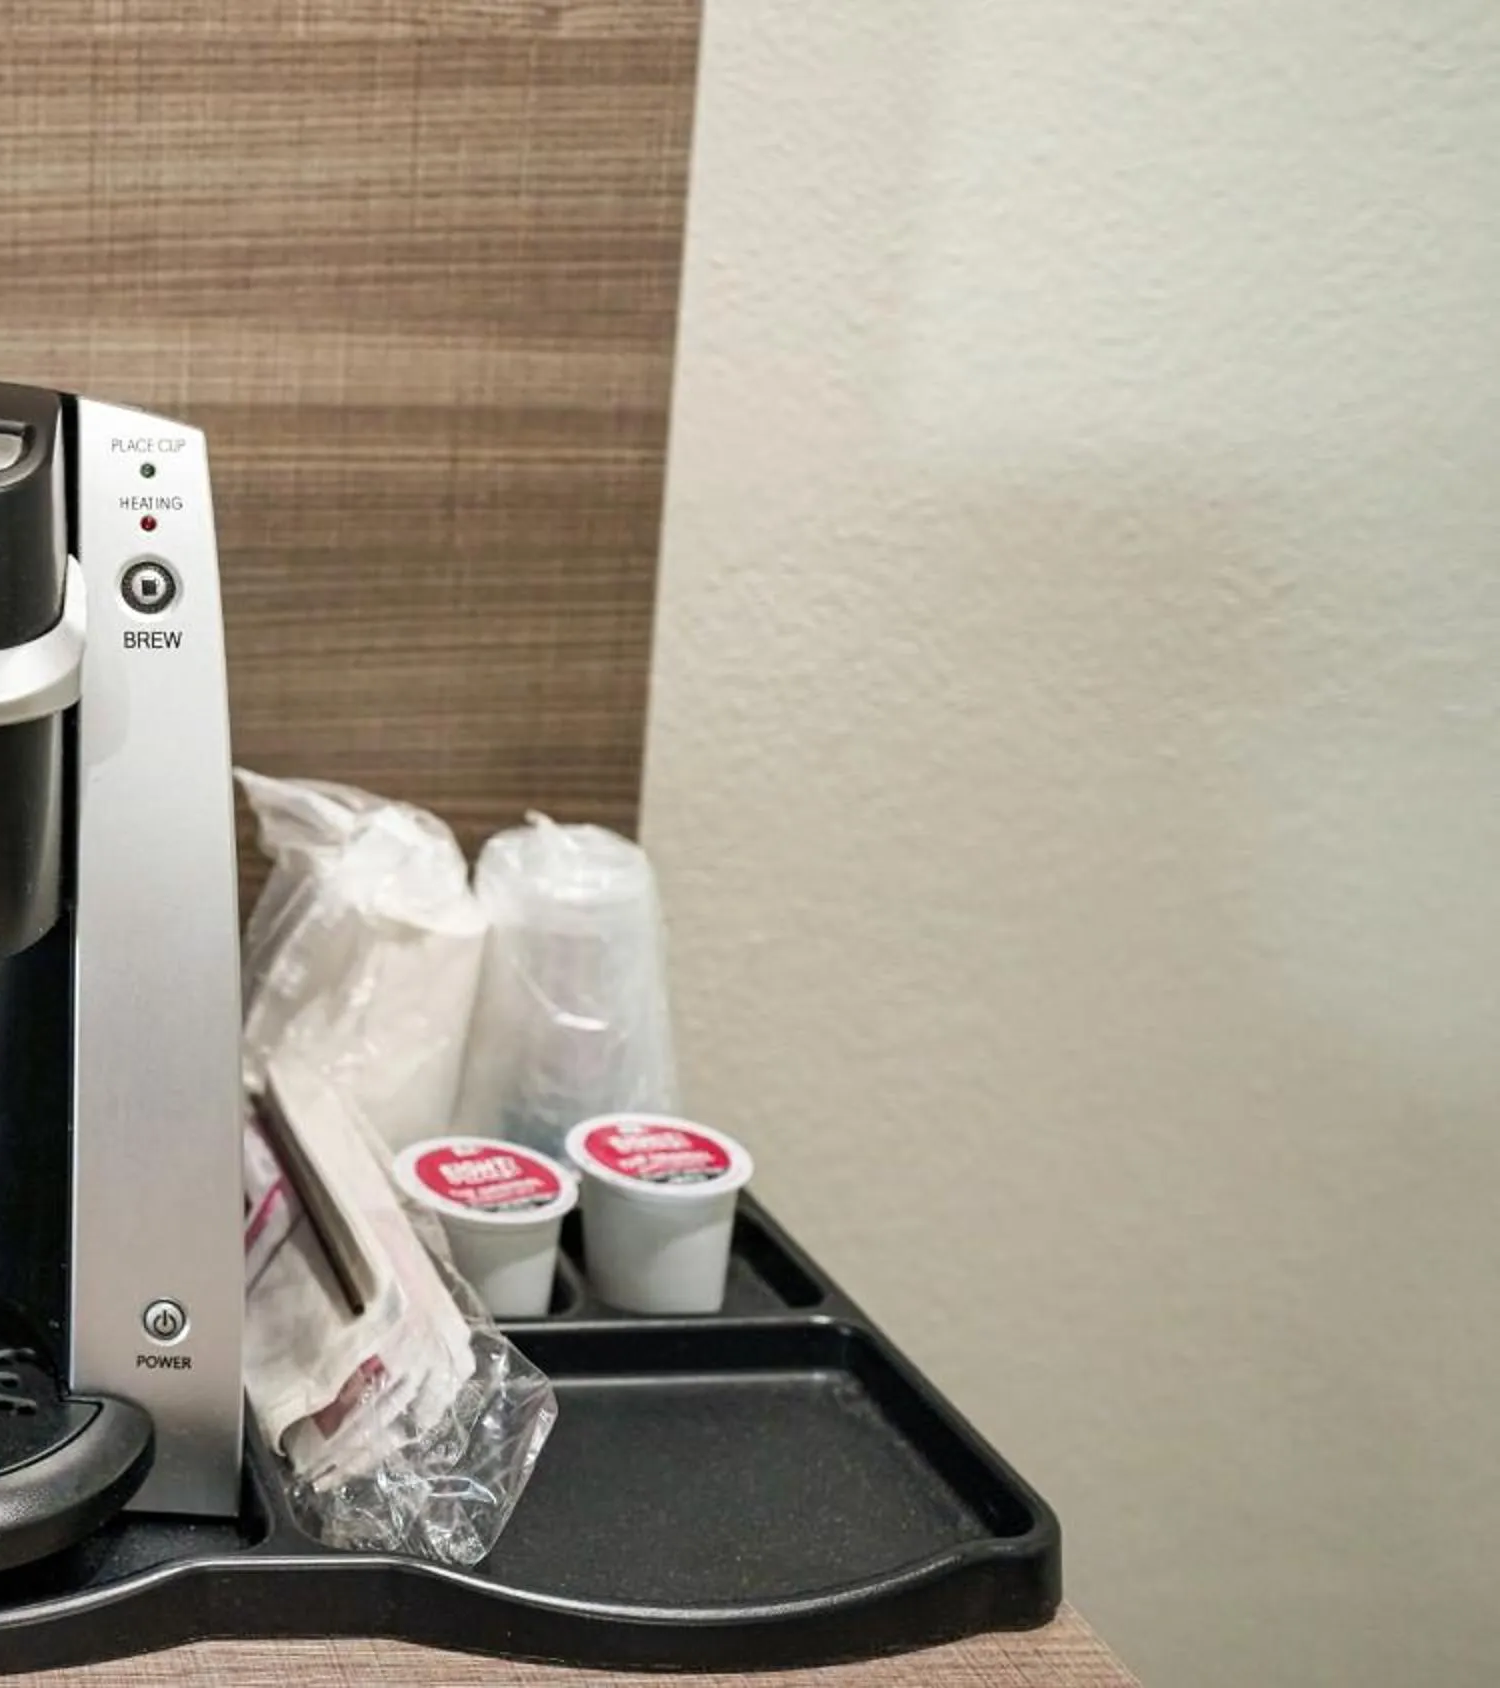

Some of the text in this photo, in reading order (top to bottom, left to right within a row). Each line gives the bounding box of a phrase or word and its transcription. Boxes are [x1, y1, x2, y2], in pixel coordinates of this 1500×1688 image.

[111, 438, 186, 453] PLACE CUP
[119, 496, 184, 511] HEATING
[123, 631, 183, 649] BREW
[136, 1354, 192, 1370] POWER
